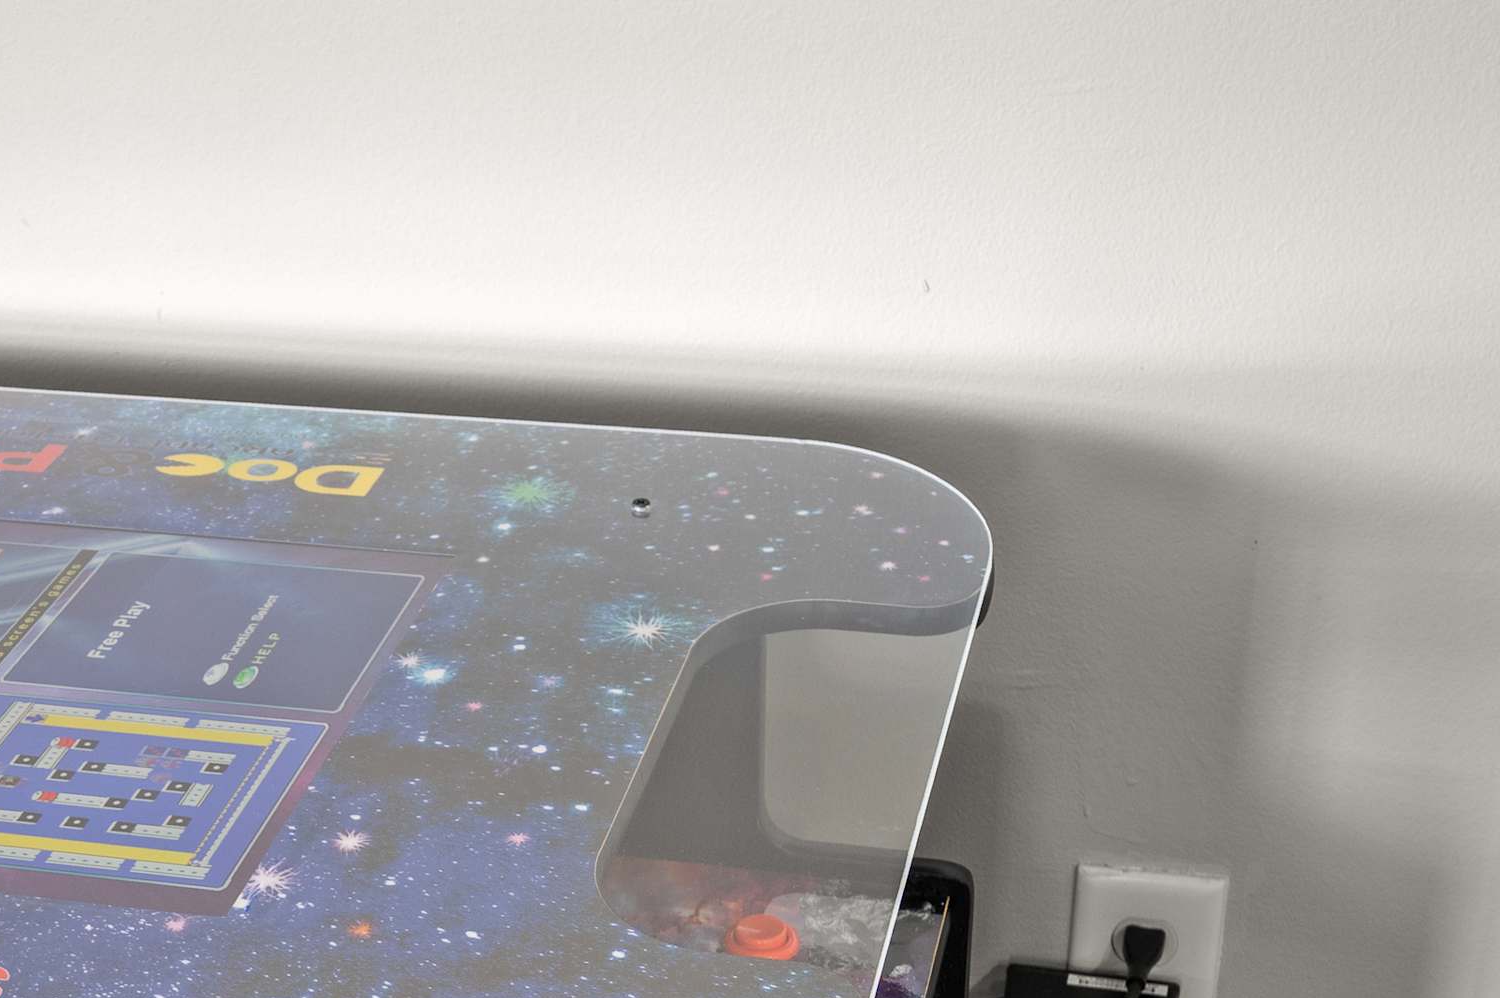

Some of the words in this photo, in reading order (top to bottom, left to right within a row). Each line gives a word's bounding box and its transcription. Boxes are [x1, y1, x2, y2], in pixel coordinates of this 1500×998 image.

[43, 563, 86, 597] games
[84, 629, 126, 659] Free
[111, 600, 155, 627] Play
[218, 622, 260, 661] Function
[248, 632, 284, 664] HELP
